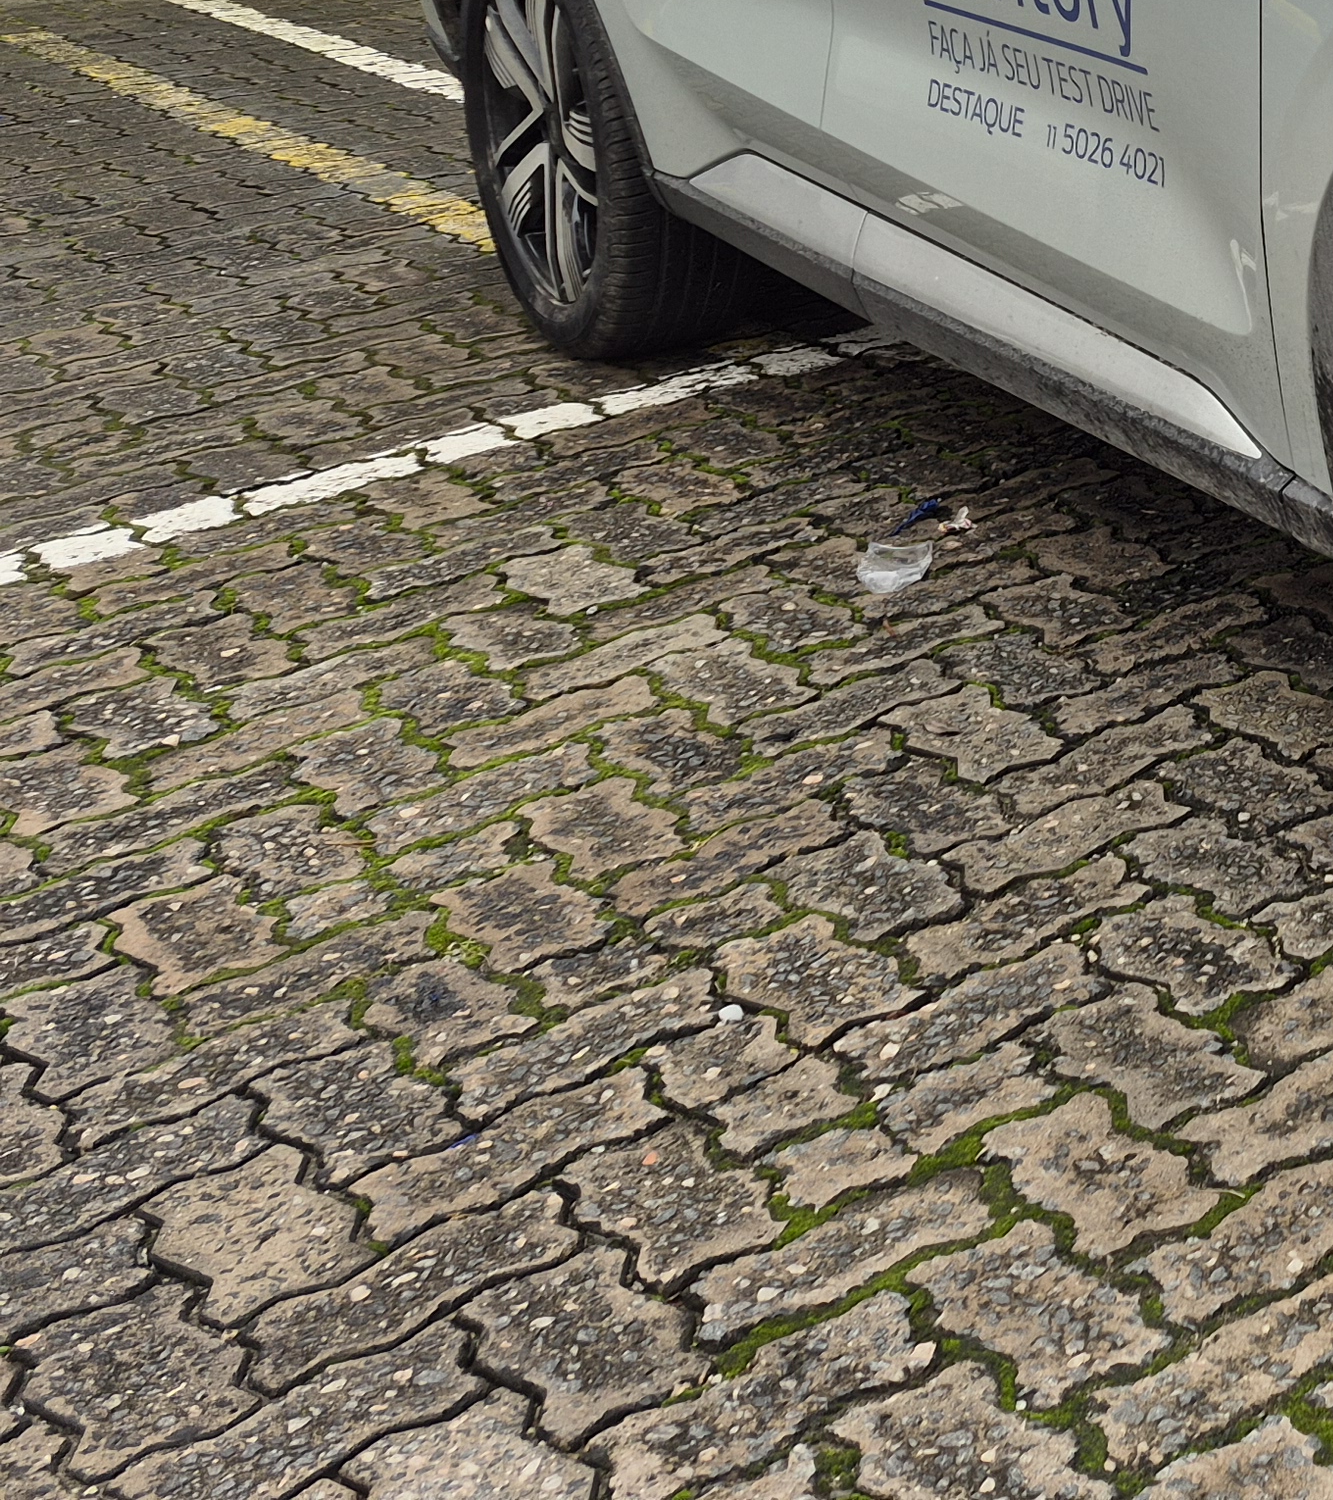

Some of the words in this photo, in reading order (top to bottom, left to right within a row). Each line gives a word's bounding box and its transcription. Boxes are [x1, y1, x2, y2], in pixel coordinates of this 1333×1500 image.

[927, 20, 975, 75] FAÇA
[979, 29, 1000, 77] JÁ
[1001, 43, 1041, 90] SEU
[1041, 56, 1094, 107] TEST
[1096, 73, 1161, 133] DRIVE
[927, 78, 1026, 138] DESTAQUE
[1061, 122, 1114, 169] 5026
[1119, 143, 1166, 188] 4021
